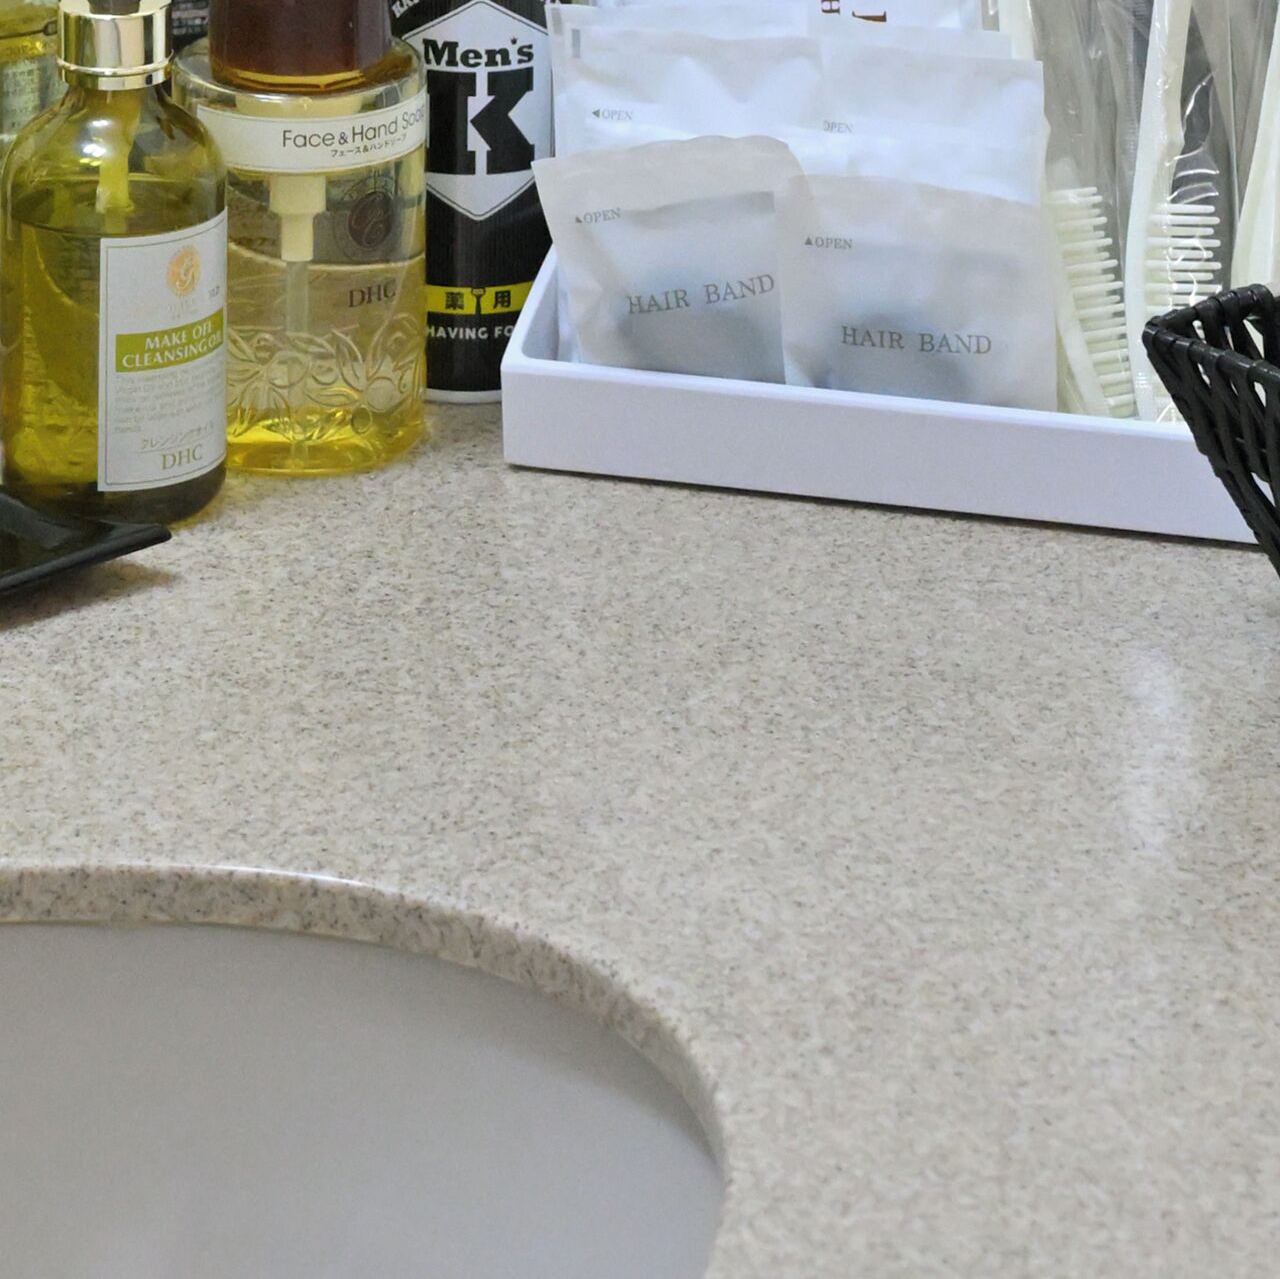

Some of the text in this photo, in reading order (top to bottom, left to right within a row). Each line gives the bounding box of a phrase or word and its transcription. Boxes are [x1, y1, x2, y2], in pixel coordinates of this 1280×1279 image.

[282, 129, 335, 149] Face
[352, 116, 399, 143] Hand
[426, 67, 535, 176] K
[583, 207, 622, 224] OPEN
[814, 236, 854, 250] OPEN
[348, 278, 397, 308] DHC
[627, 274, 775, 314] HAIR BAND
[145, 329, 188, 350] MAKE
[427, 324, 489, 340] HAVING
[841, 325, 992, 355] HAIR BAND
[162, 443, 203, 470] DHC
